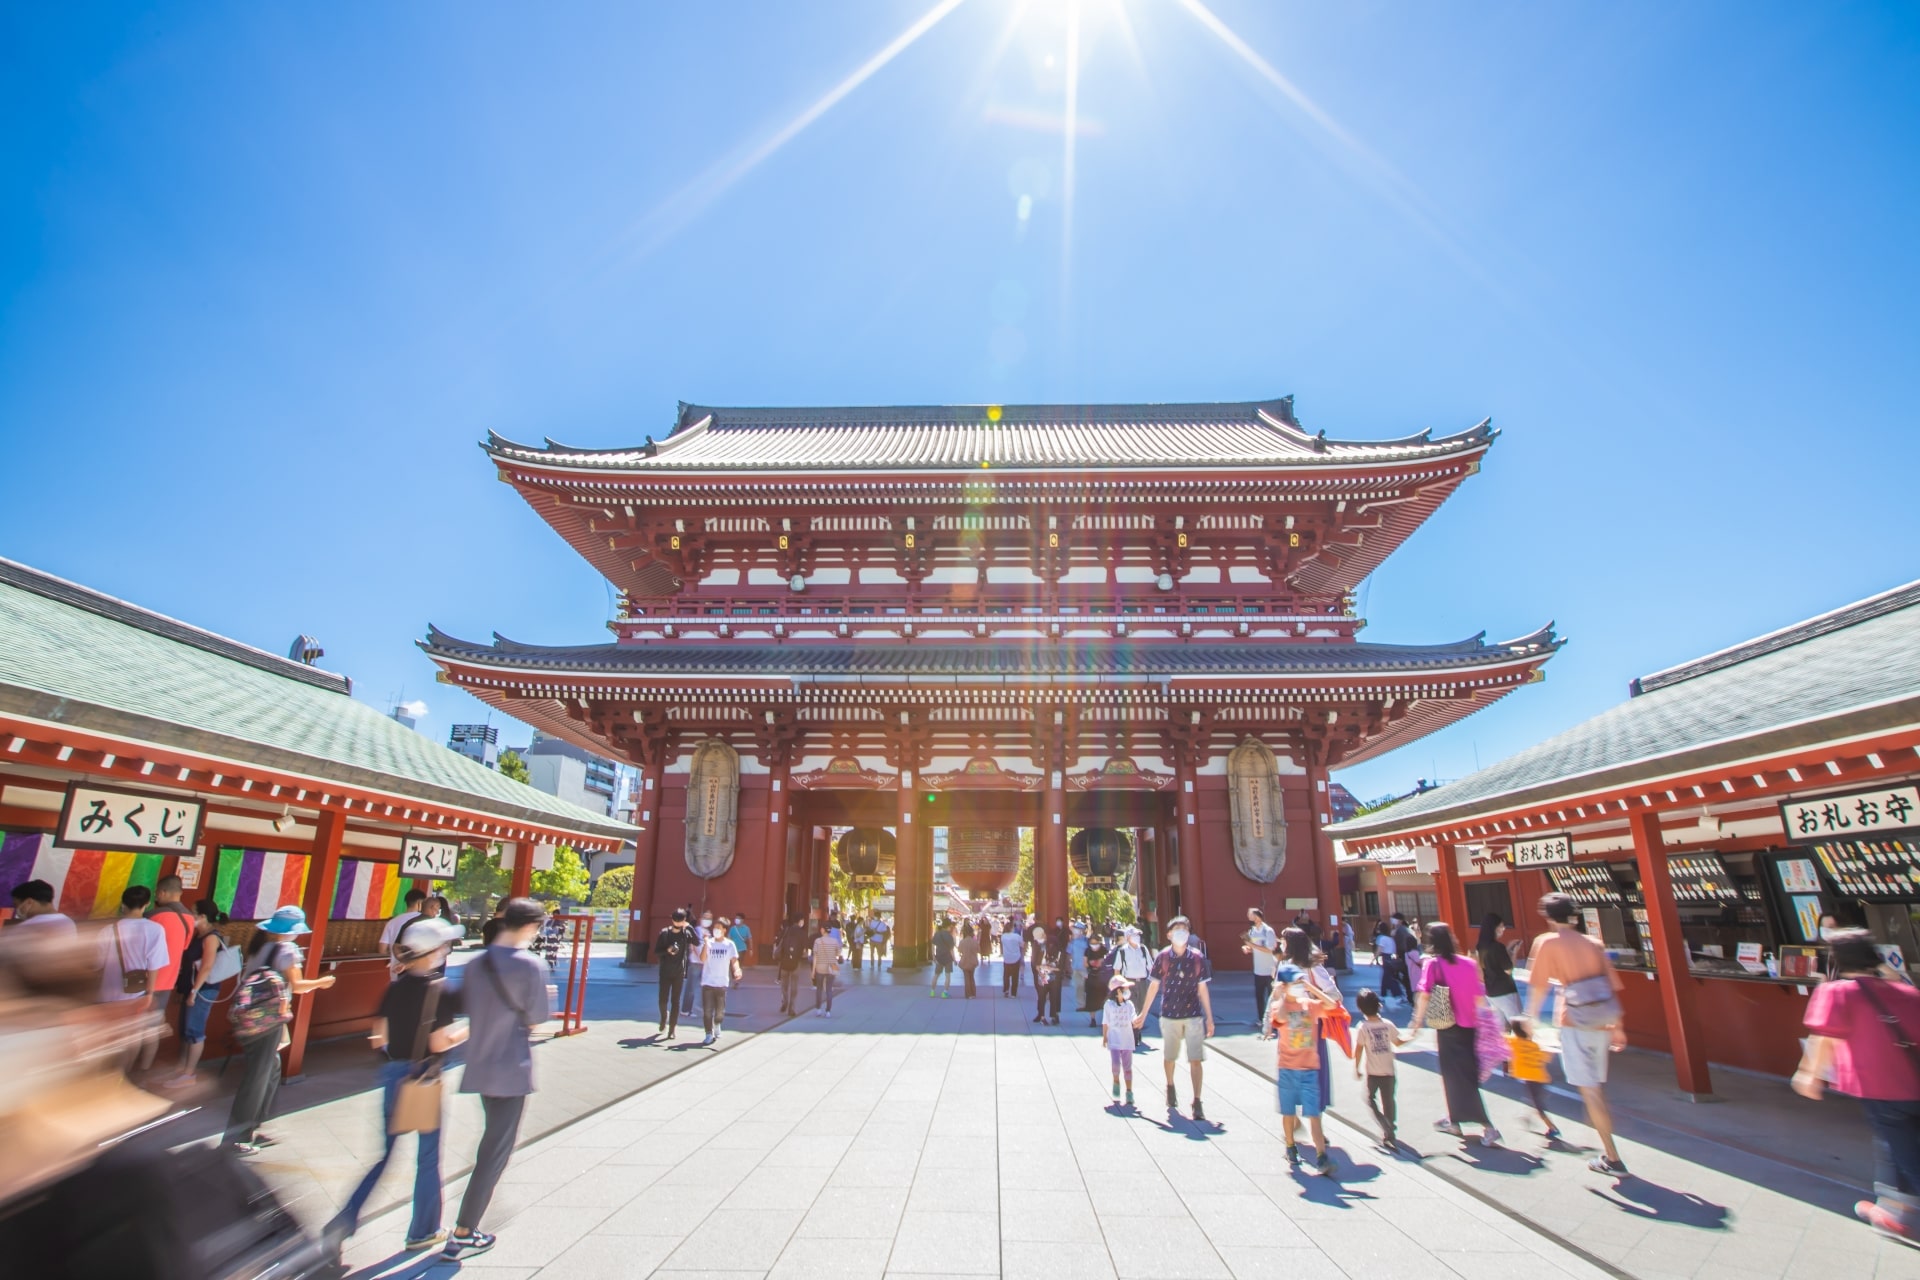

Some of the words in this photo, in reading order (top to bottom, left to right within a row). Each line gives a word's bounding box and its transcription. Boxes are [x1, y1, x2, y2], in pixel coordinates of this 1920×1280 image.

[80, 800, 186, 838] みくじ
[1797, 794, 1913, 833] お札お守
[149, 833, 185, 846] 百円
[1520, 841, 1566, 863] お札お守
[408, 845, 452, 870] みくじ
